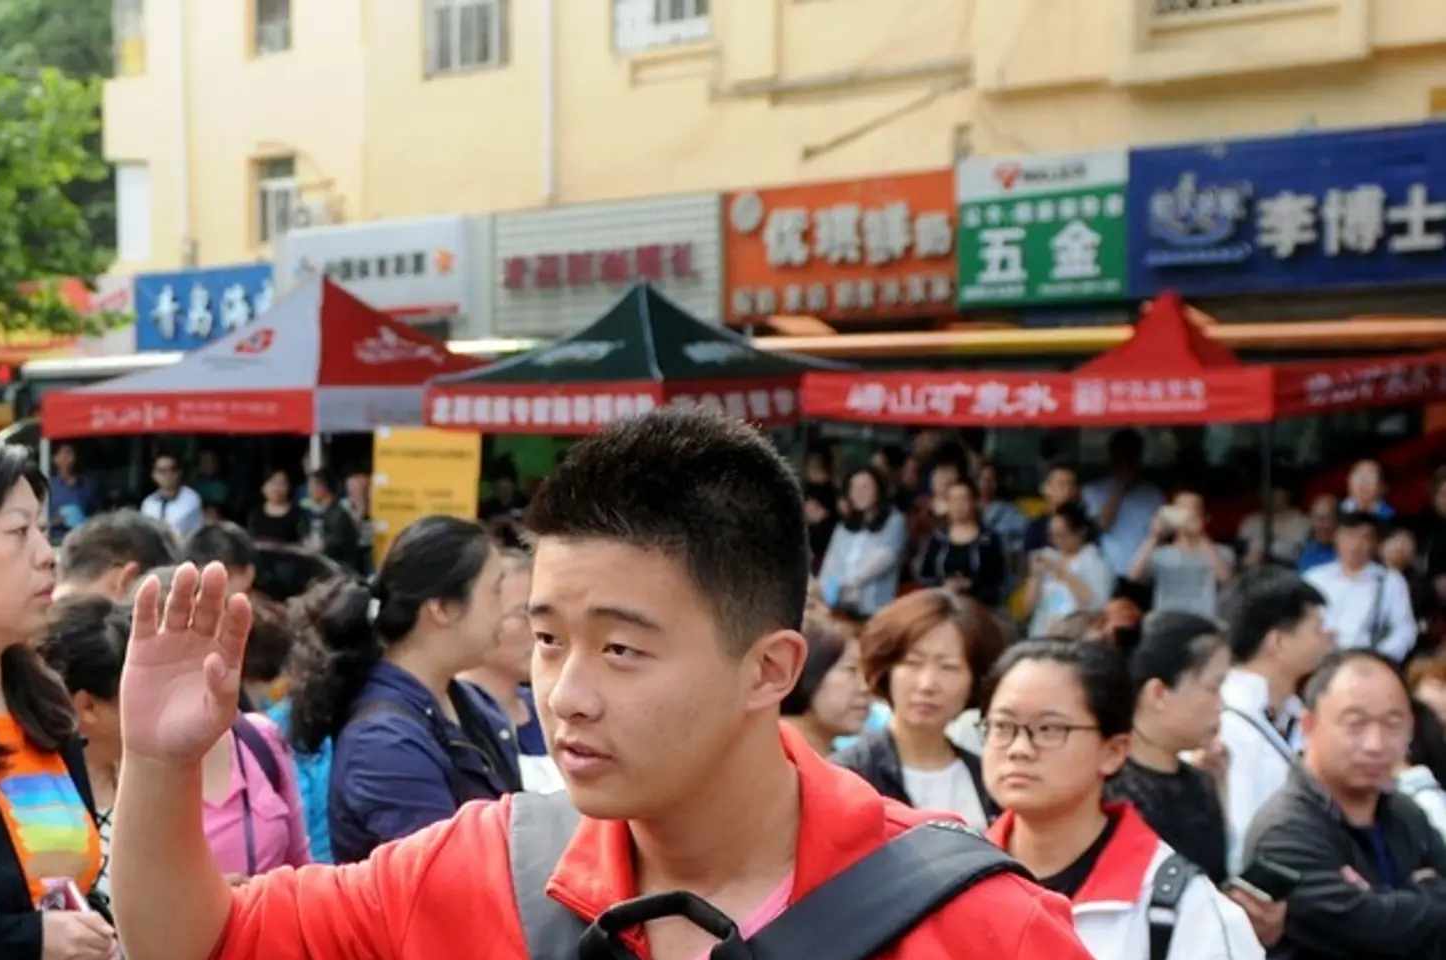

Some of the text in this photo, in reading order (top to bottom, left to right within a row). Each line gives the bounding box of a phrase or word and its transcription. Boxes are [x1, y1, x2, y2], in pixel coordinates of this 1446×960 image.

[976, 220, 1103, 285] 五金
[846, 381, 1058, 417] 崂山矿泉水
